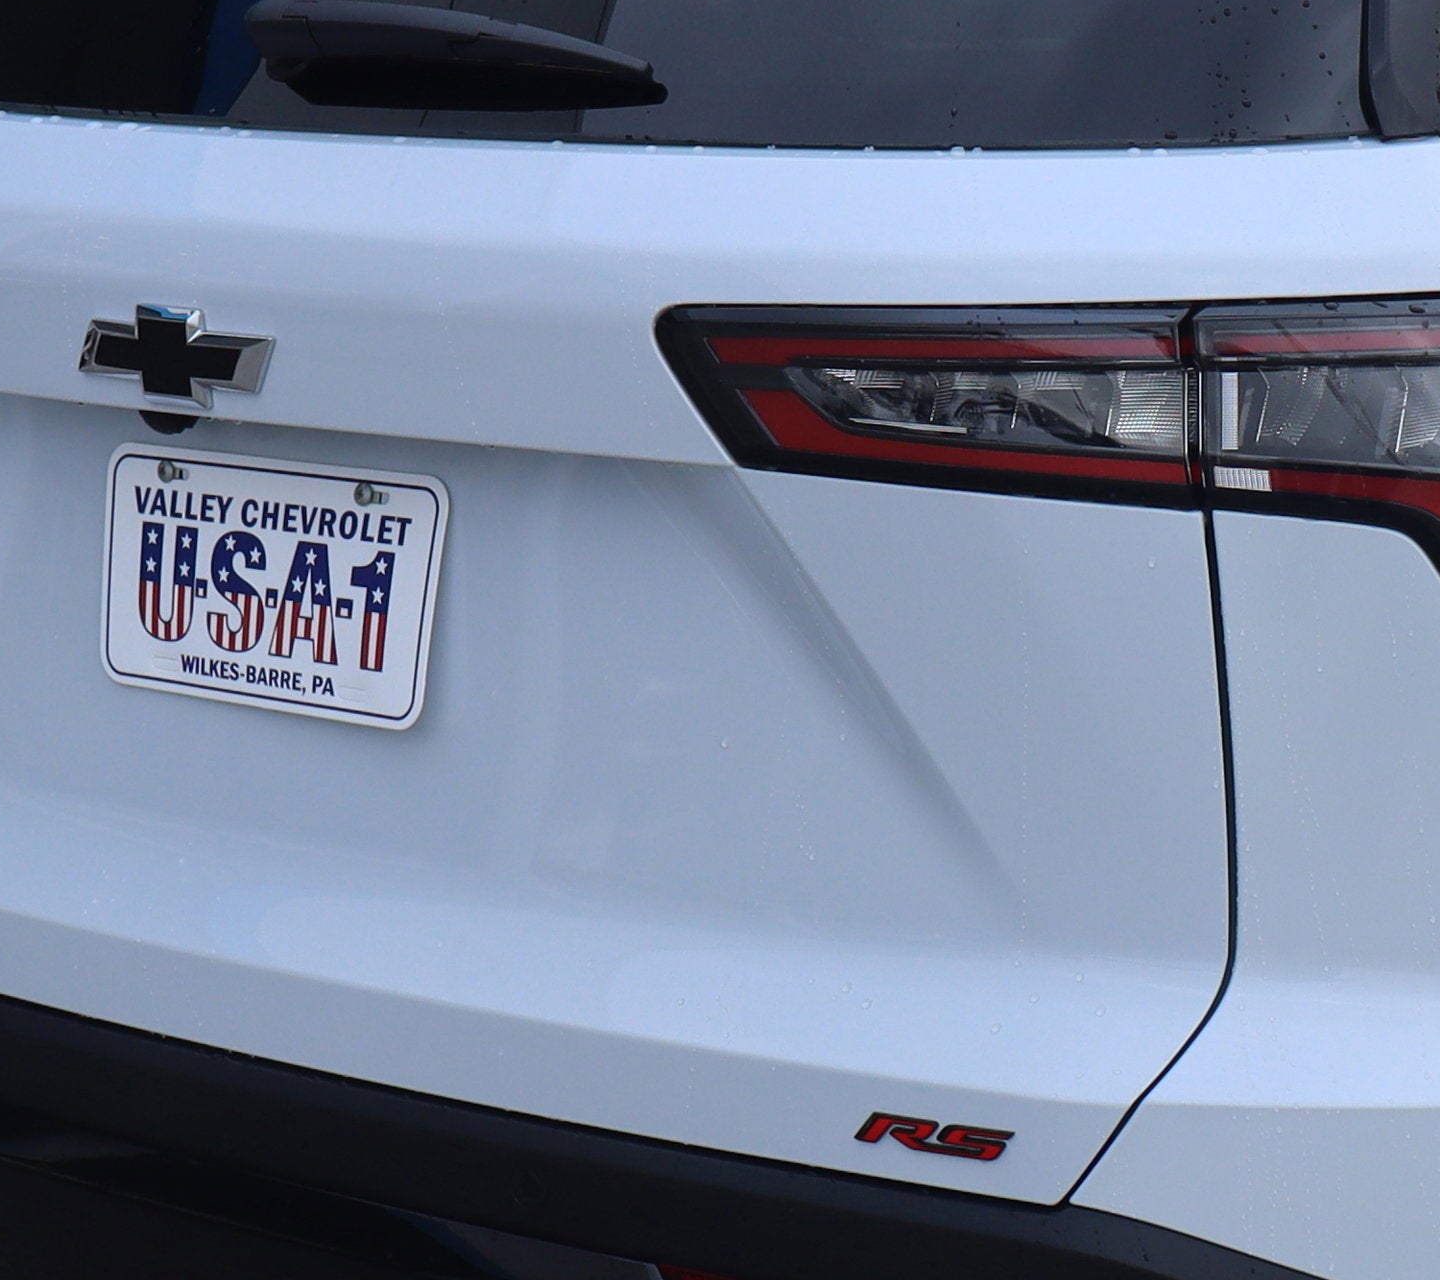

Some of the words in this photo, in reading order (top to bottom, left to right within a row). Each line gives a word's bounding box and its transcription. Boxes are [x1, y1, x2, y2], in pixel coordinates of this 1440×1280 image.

[134, 485, 234, 524] VALLEY
[240, 498, 413, 547] CHEVROLET
[180, 654, 307, 696] WILKES-BARRE,
[311, 676, 335, 697] PA
[853, 1110, 1016, 1162] RS
